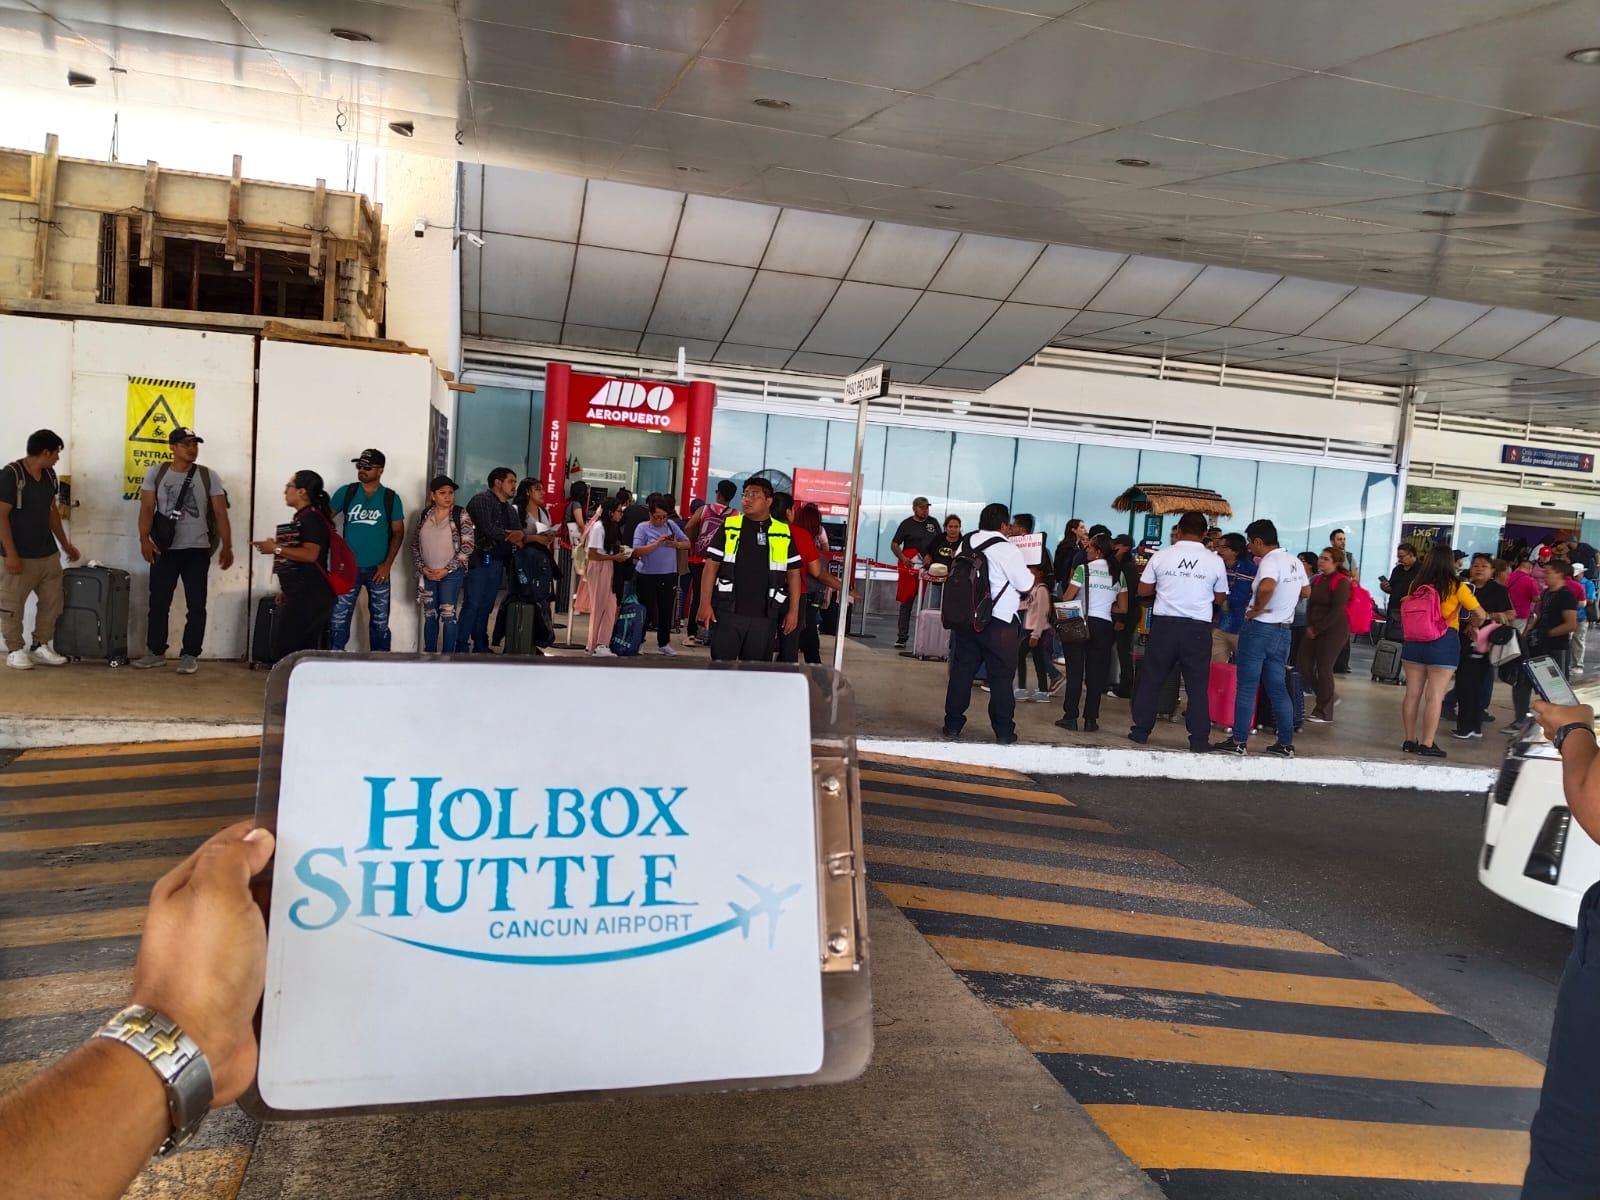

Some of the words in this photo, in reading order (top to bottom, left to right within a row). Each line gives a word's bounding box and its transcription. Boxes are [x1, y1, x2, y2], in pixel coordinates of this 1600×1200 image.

[588, 380, 675, 411] ADO
[586, 408, 671, 426] AEROPUERTO
[133, 449, 175, 460] ENTRAD
[134, 458, 141, 466] Y
[547, 420, 560, 494] SHUTTLE
[348, 503, 382, 522] Aero
[355, 776, 689, 853] HOLBOX
[288, 847, 699, 931] SHUTTLE
[489, 917, 587, 939] CANCUN
[595, 913, 693, 935] AIRPORT
